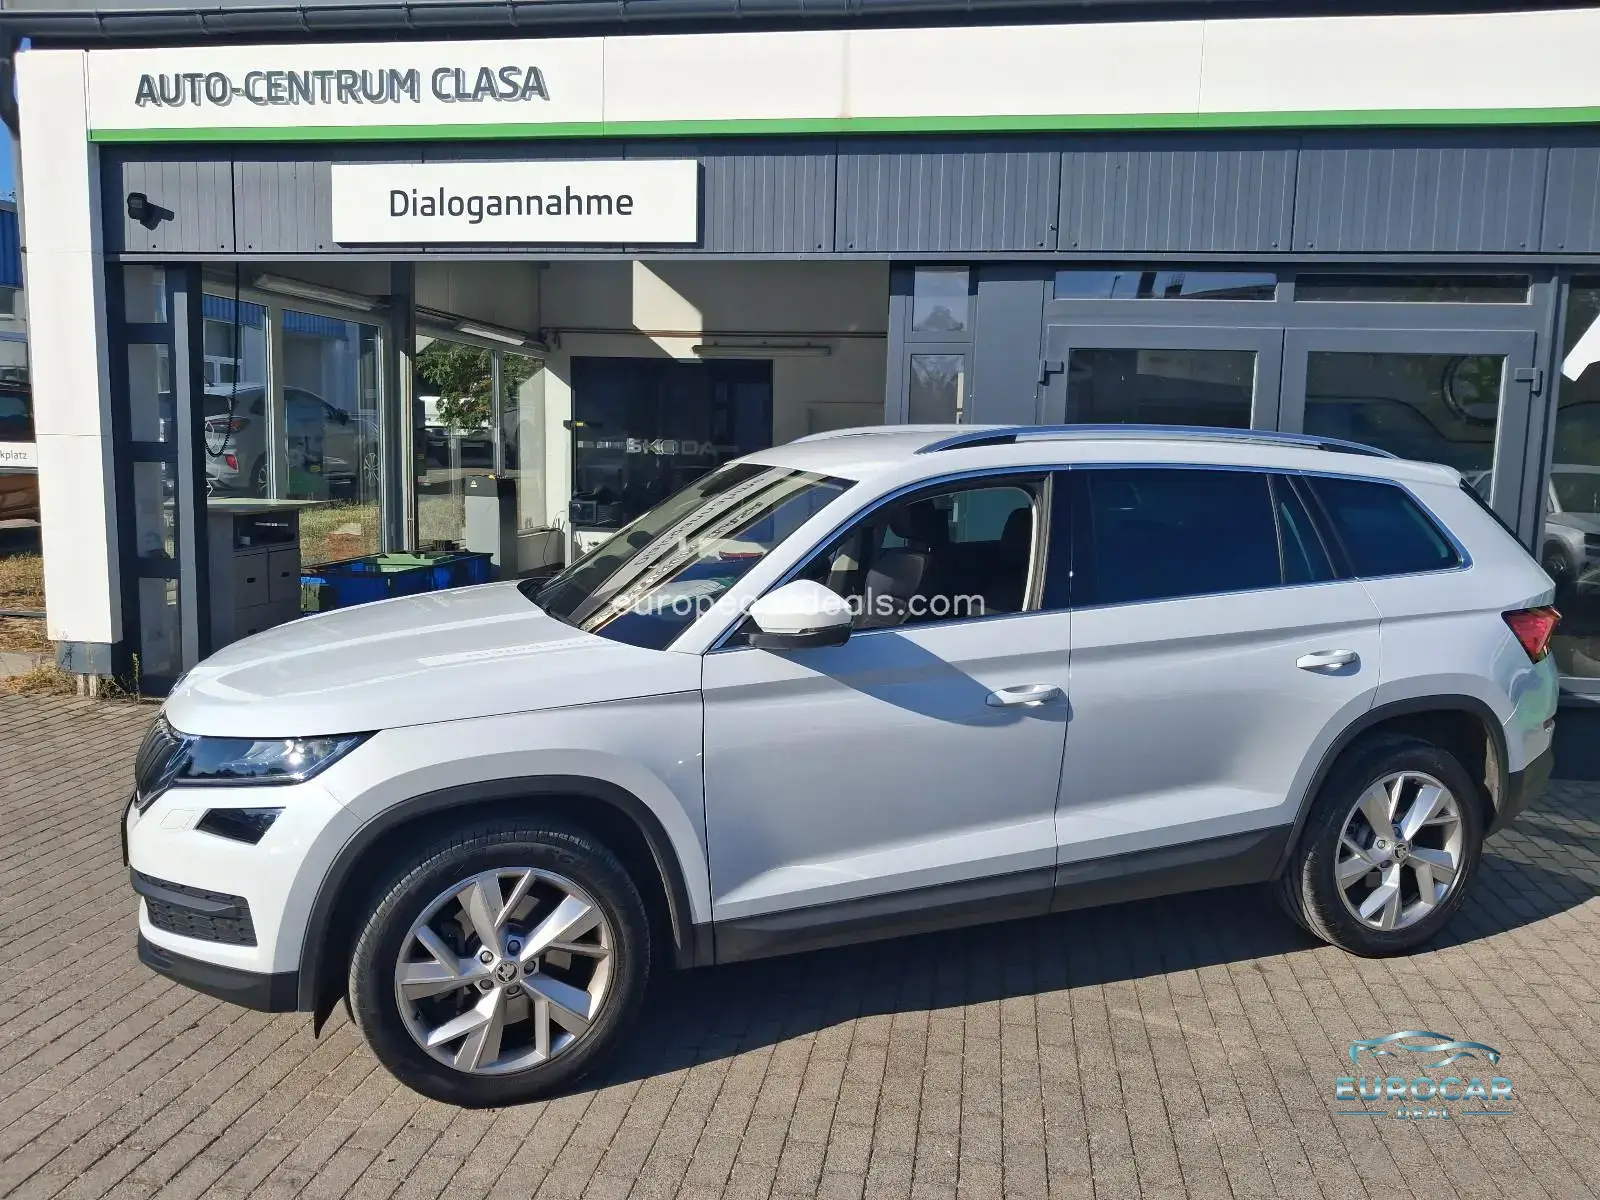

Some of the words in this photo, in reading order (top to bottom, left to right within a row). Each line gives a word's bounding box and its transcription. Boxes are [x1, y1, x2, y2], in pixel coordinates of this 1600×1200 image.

[135, 69, 421, 107] AUTO-CENTRUM
[431, 66, 550, 103] CLASA
[389, 185, 634, 224] Dialogannahme
